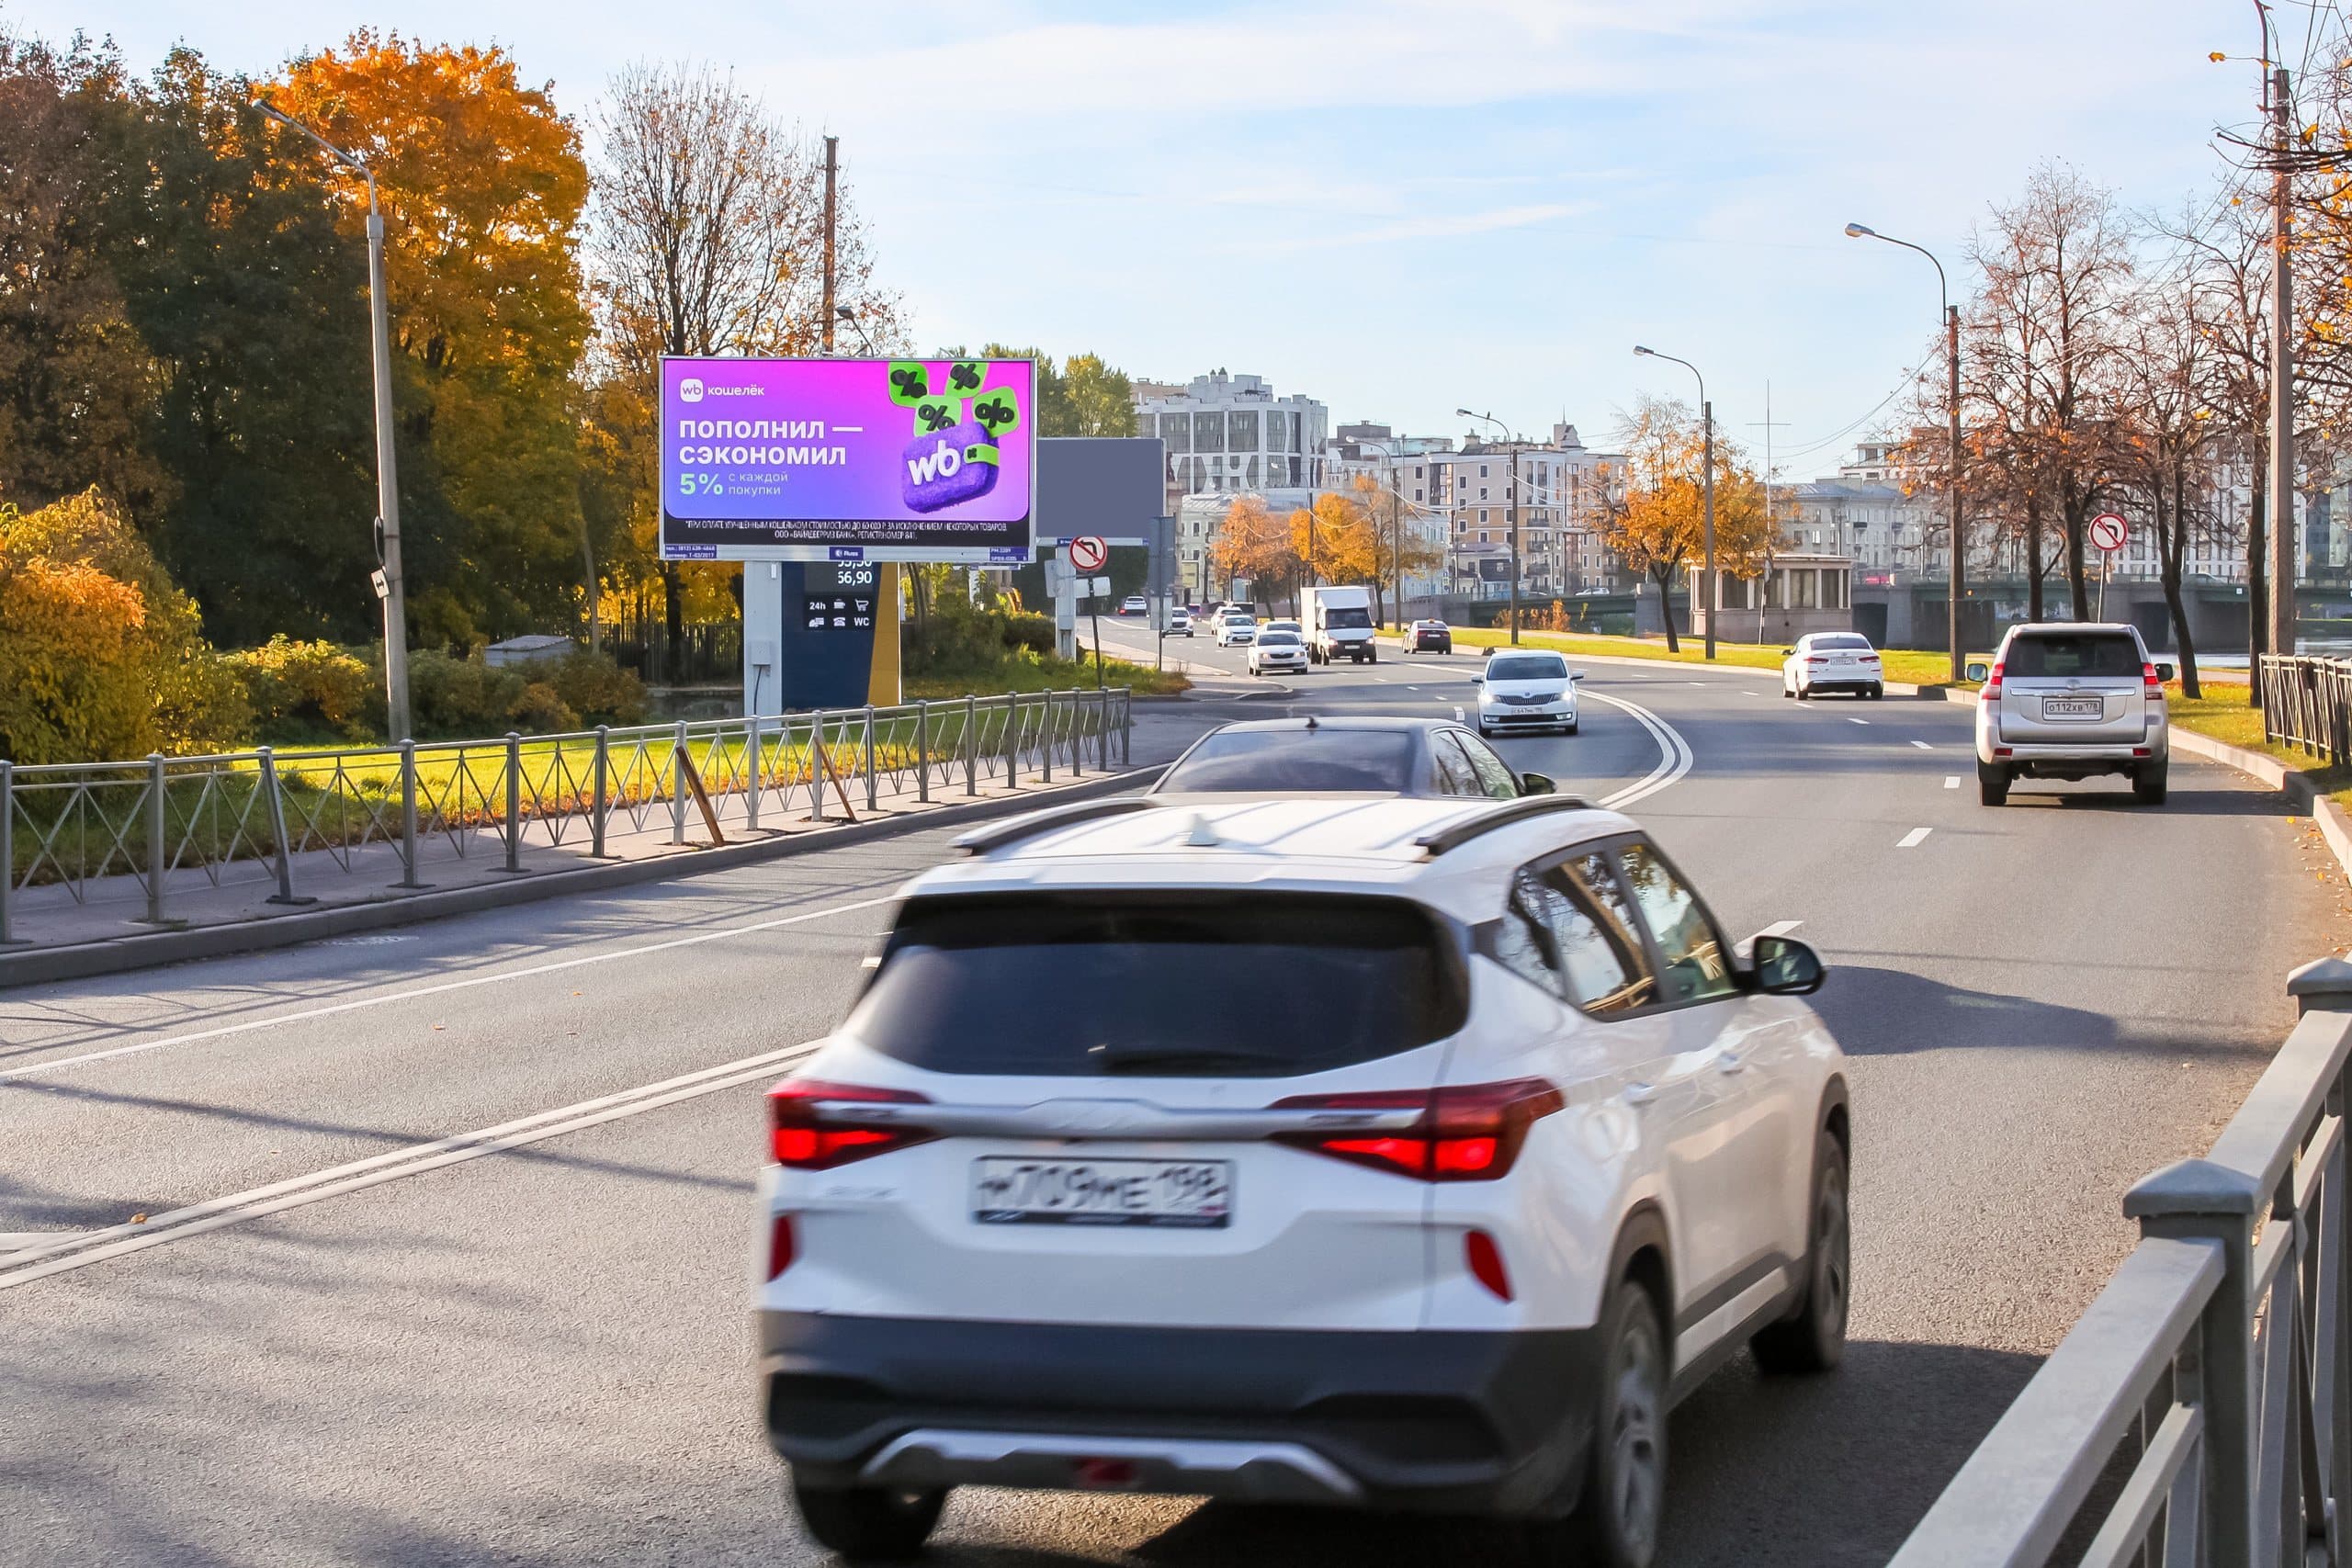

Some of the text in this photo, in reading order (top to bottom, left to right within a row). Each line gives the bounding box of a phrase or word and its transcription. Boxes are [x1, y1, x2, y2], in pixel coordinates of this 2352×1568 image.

[683, 384, 701, 395] wb
[707, 384, 765, 396] кошелёк
[907, 439, 961, 485] wb
[740, 471, 788, 483] каждой
[680, 473, 723, 495] 5%
[729, 486, 781, 497] покупки
[809, 602, 826, 610] 24h
[854, 617, 870, 626] WC
